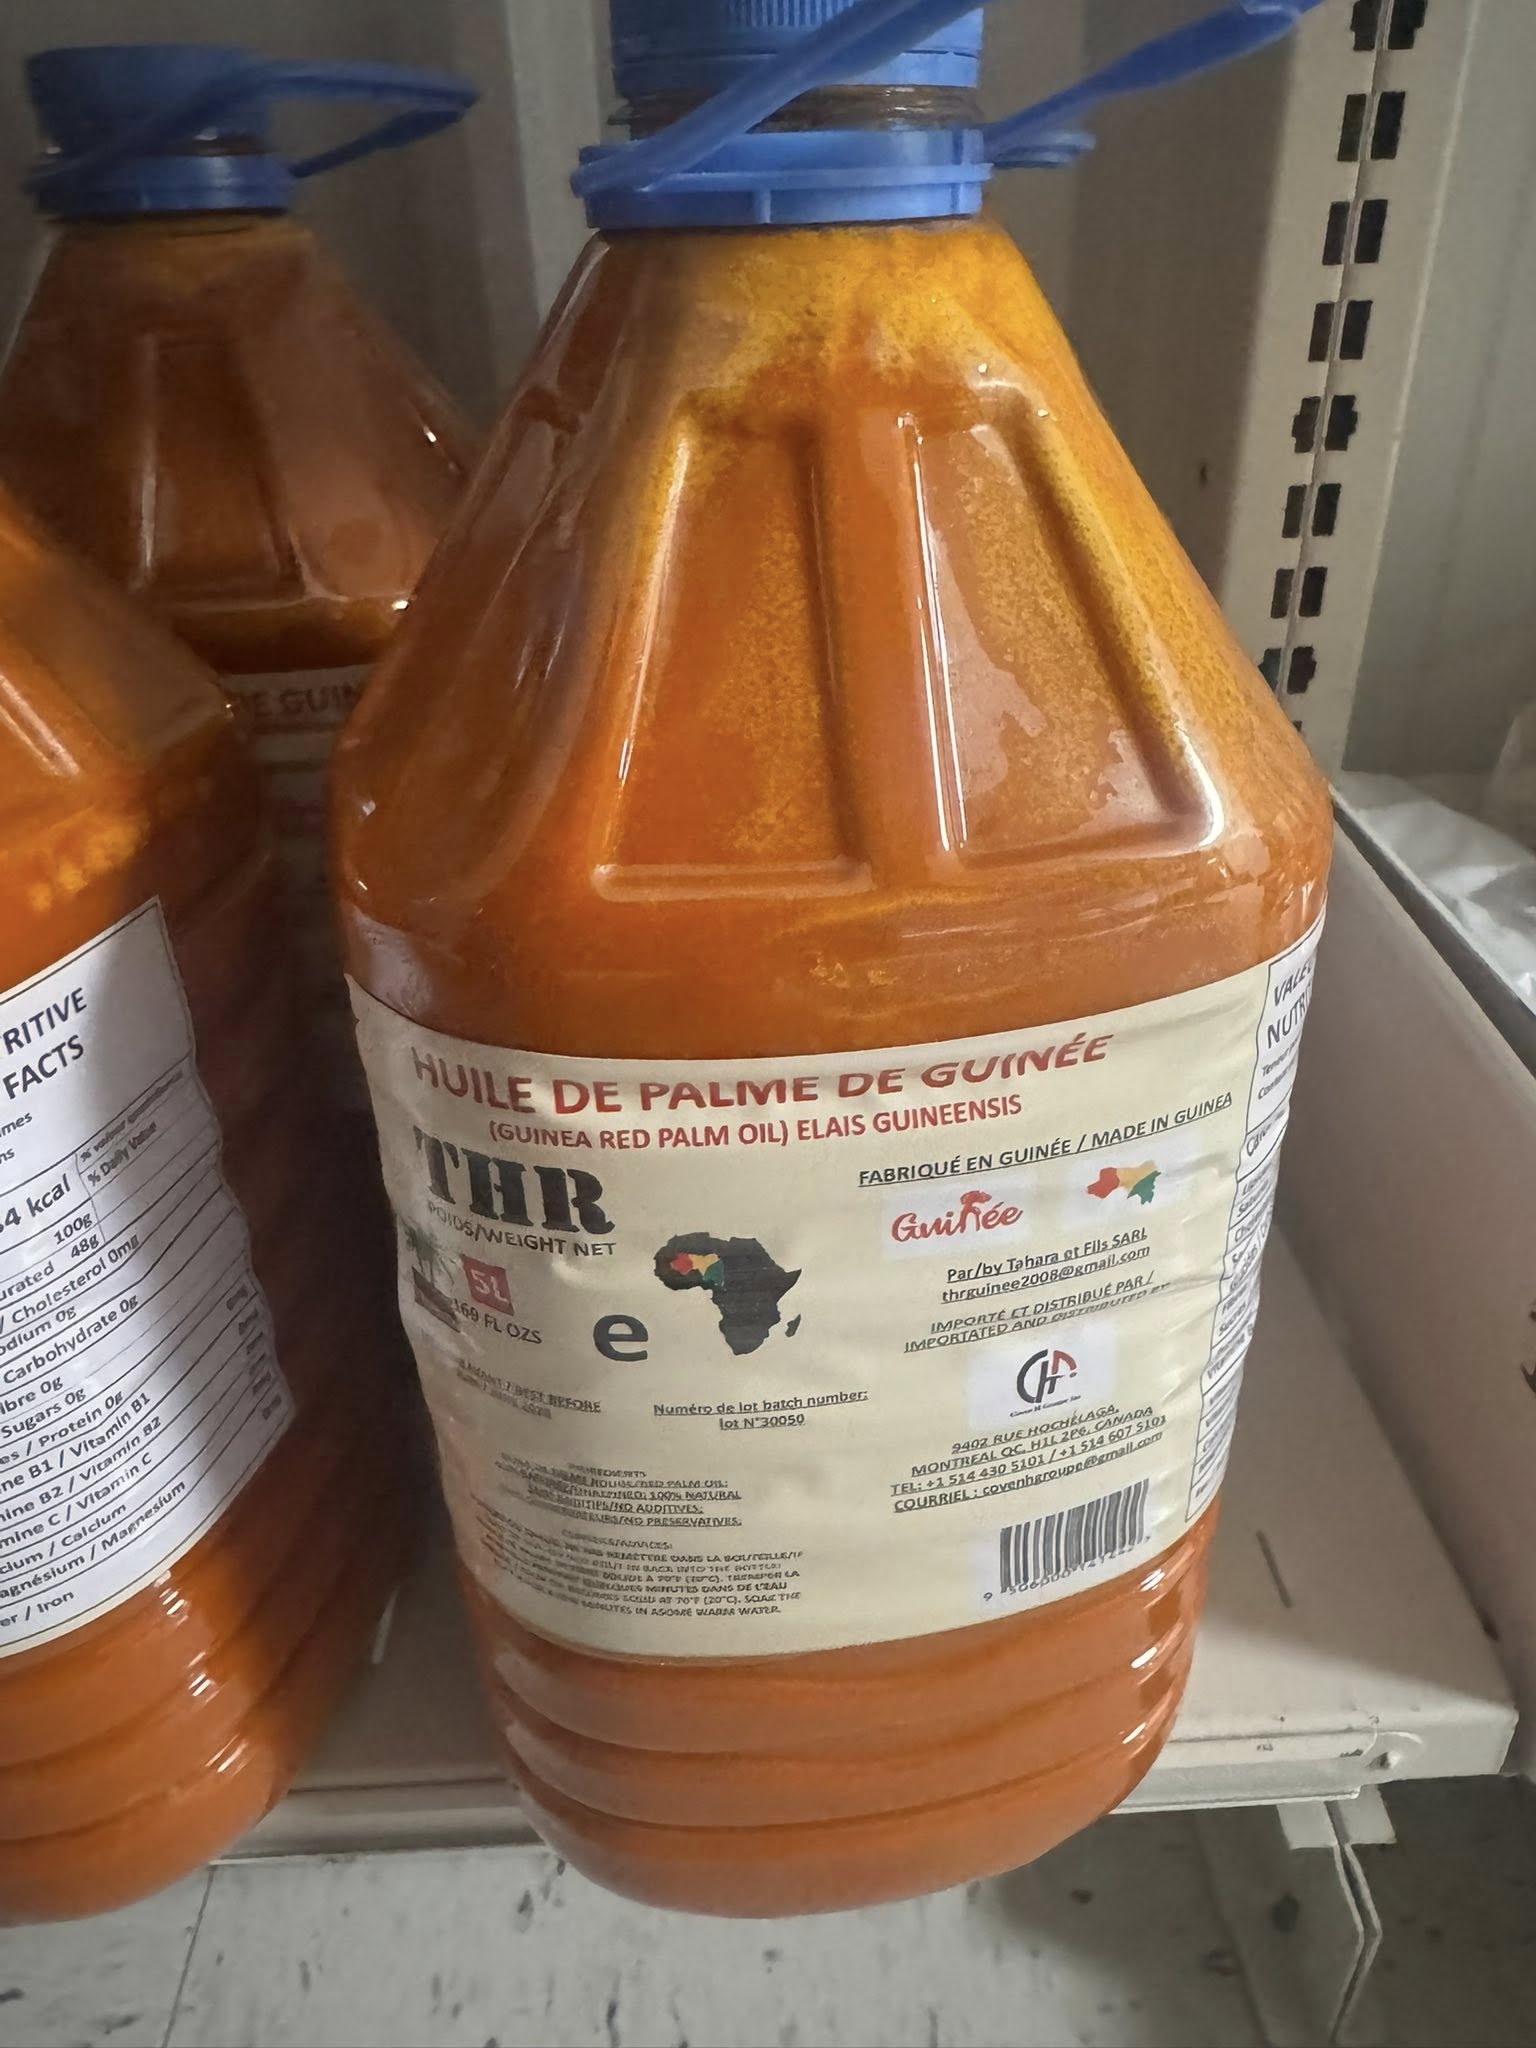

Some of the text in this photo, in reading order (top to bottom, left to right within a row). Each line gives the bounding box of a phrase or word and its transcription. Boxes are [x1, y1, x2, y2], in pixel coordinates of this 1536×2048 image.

[3, 1034, 84, 1100] FACTS
[411, 1032, 1114, 1114] HUILE DE PALME DE GUINÉE
[0, 1111, 33, 1138] mes
[489, 1094, 1022, 1149] (GUINEA RED PALM OIL) ELAIS GUINEENSIS
[859, 1092, 1232, 1186] FABRIQUÉ EN GUINÉE / MADE IN GUINEA
[0, 1173, 72, 1234] 4 kcal
[413, 1125, 615, 1235] THR
[53, 1213, 93, 1246] 100g
[427, 1202, 616, 1257] POIDS/WEIGHT NET
[891, 1191, 1025, 1243] Guinée
[71, 1234, 100, 1259] 48g
[942, 1246, 1150, 1302] thrguinee2008@gmail.com
[947, 1262, 1003, 1283] Par/by
[1007, 1252, 1059, 1272] Tahara
[1112, 1227, 1148, 1246] SARL
[12, 1257, 107, 1324] Cholesterol
[55, 1305, 77, 1324] 0g
[930, 1309, 1006, 1334] IMPORTÉ
[1010, 1305, 1029, 1320] ET
[1033, 1282, 1112, 1315] DISTRIBUÉ
[1116, 1275, 1143, 1293] PAR
[3, 1295, 139, 1385] Carbohydrate 0g
[484, 1313, 502, 1334] FL
[507, 1323, 542, 1345] OZS
[593, 1314, 648, 1362] e
[905, 1324, 1008, 1352] IMPORTATED
[1011, 1315, 1048, 1332] AND
[0, 1387, 87, 1439] Sugars 0g
[40, 1376, 63, 1395] 0g
[653, 1403, 712, 1416] Numéro
[717, 1404, 735, 1415] de
[738, 1401, 758, 1413] lot
[763, 1396, 803, 1411] batch
[28, 1458, 54, 1480] B1
[59, 1449, 65, 1469] /
[69, 1413, 132, 1459] Vitamin
[130, 1392, 151, 1415] B1
[38, 1407, 103, 1448] Protein
[104, 1391, 124, 1411] 0g
[719, 1418, 739, 1431] lot
[911, 1450, 998, 1478] MONTREAL
[1095, 1406, 1153, 1432] CANADA
[952, 1437, 988, 1455] 9402
[993, 1429, 1025, 1445] RUE
[39, 1486, 64, 1506] B2
[69, 1476, 75, 1494] /
[79, 1434, 141, 1482] Vitamin
[142, 1416, 162, 1438] B2
[890, 1482, 922, 1497] TEL:
[927, 1477, 945, 1488] +1
[949, 1471, 976, 1486] 514
[980, 1463, 1007, 1478] 430
[1011, 1454, 1044, 1472] 5101
[1059, 1445, 1077, 1457] +1
[1080, 1436, 1105, 1451] 514
[1108, 1425, 1133, 1440] 607
[1136, 1414, 1167, 1432] 5101
[48, 1512, 62, 1528] C
[66, 1504, 72, 1523] /
[76, 1464, 140, 1511] Vitamin
[142, 1453, 152, 1467] C
[894, 1489, 971, 1512] COURRIEL
[61, 1503, 127, 1548] Calcium
[90, 1544, 96, 1561] /
[101, 1481, 186, 1551] Magnesium
[37, 1591, 75, 1613] Iron
